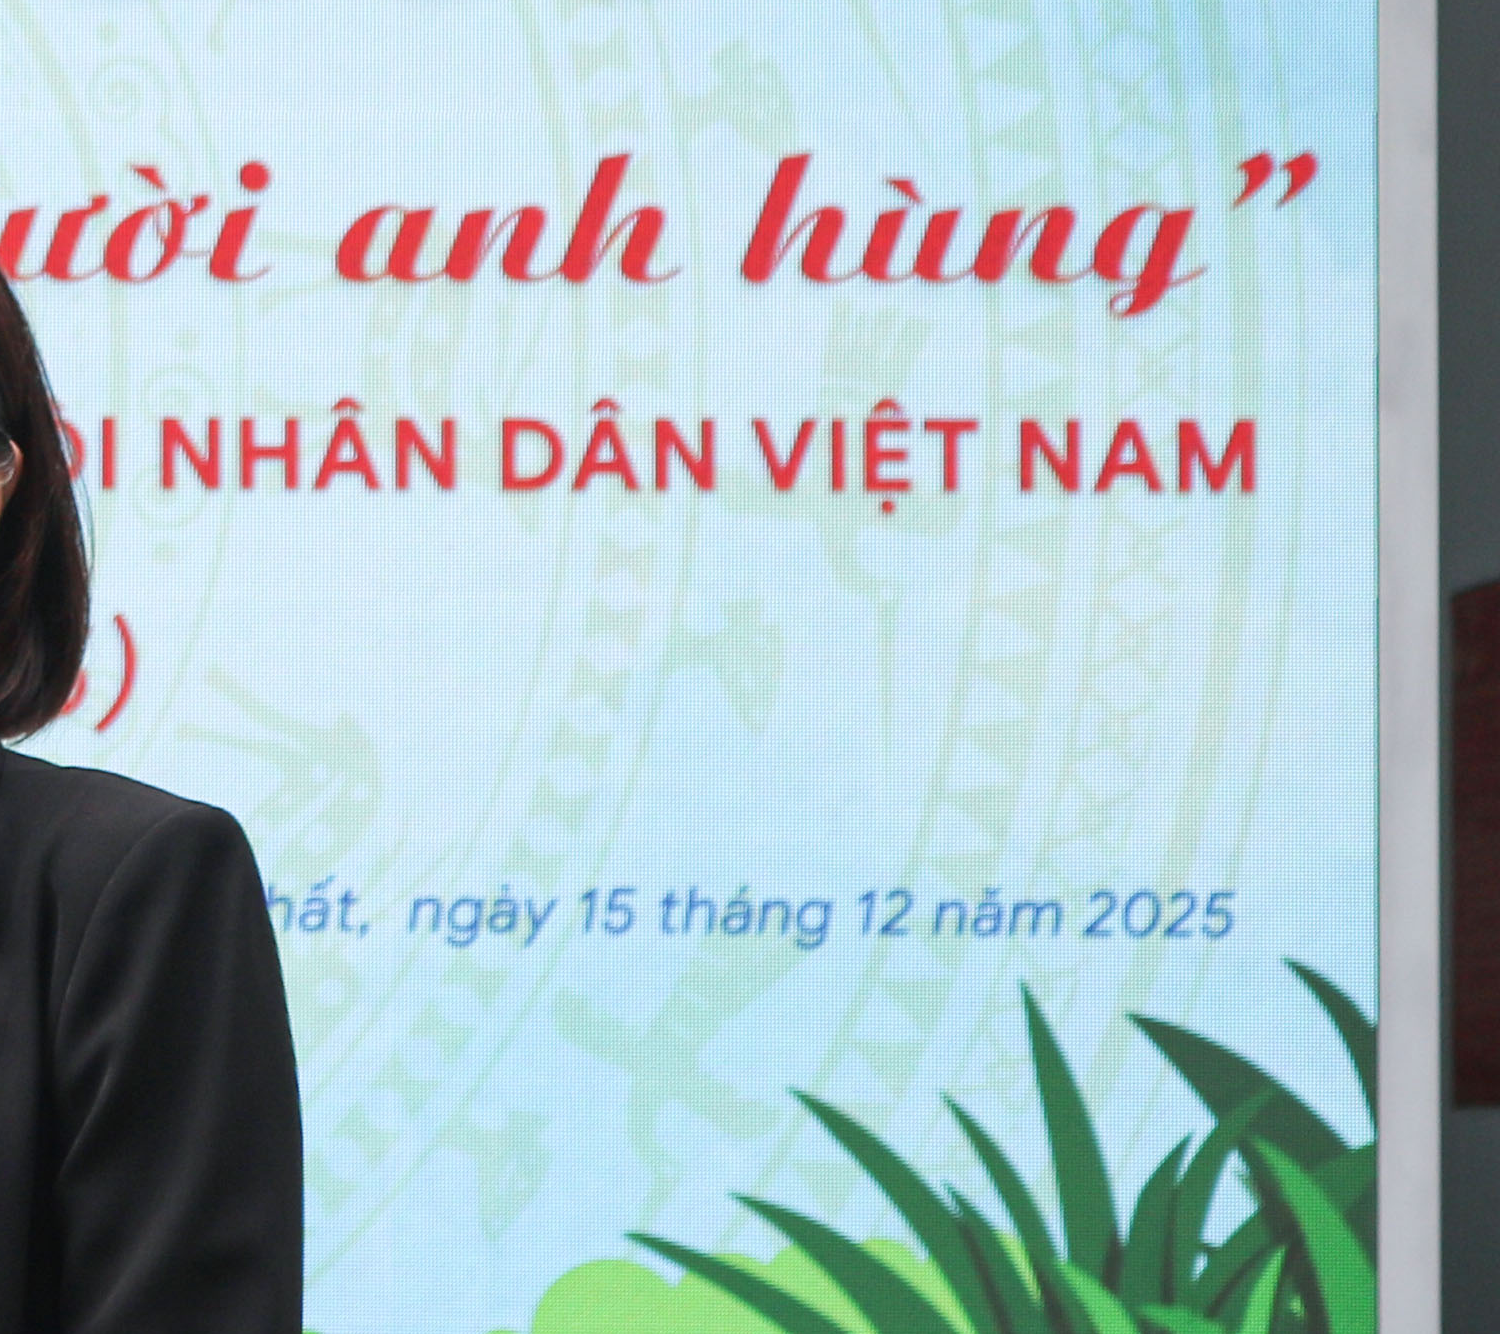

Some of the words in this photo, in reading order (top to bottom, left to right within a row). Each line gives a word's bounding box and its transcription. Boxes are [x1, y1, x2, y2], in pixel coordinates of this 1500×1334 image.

[336, 153, 680, 283] anh
[161, 397, 457, 490] NHÂN
[502, 398, 716, 491] DÂN
[752, 398, 979, 514] VIỆT
[1019, 419, 1257, 492] NAM
[264, 875, 371, 937] hất,
[408, 883, 560, 948] ngày
[580, 886, 638, 939] 15
[658, 884, 835, 951] tháng
[855, 887, 916, 939] 12
[931, 886, 1065, 940] năm
[1081, 888, 1238, 941] 2025
